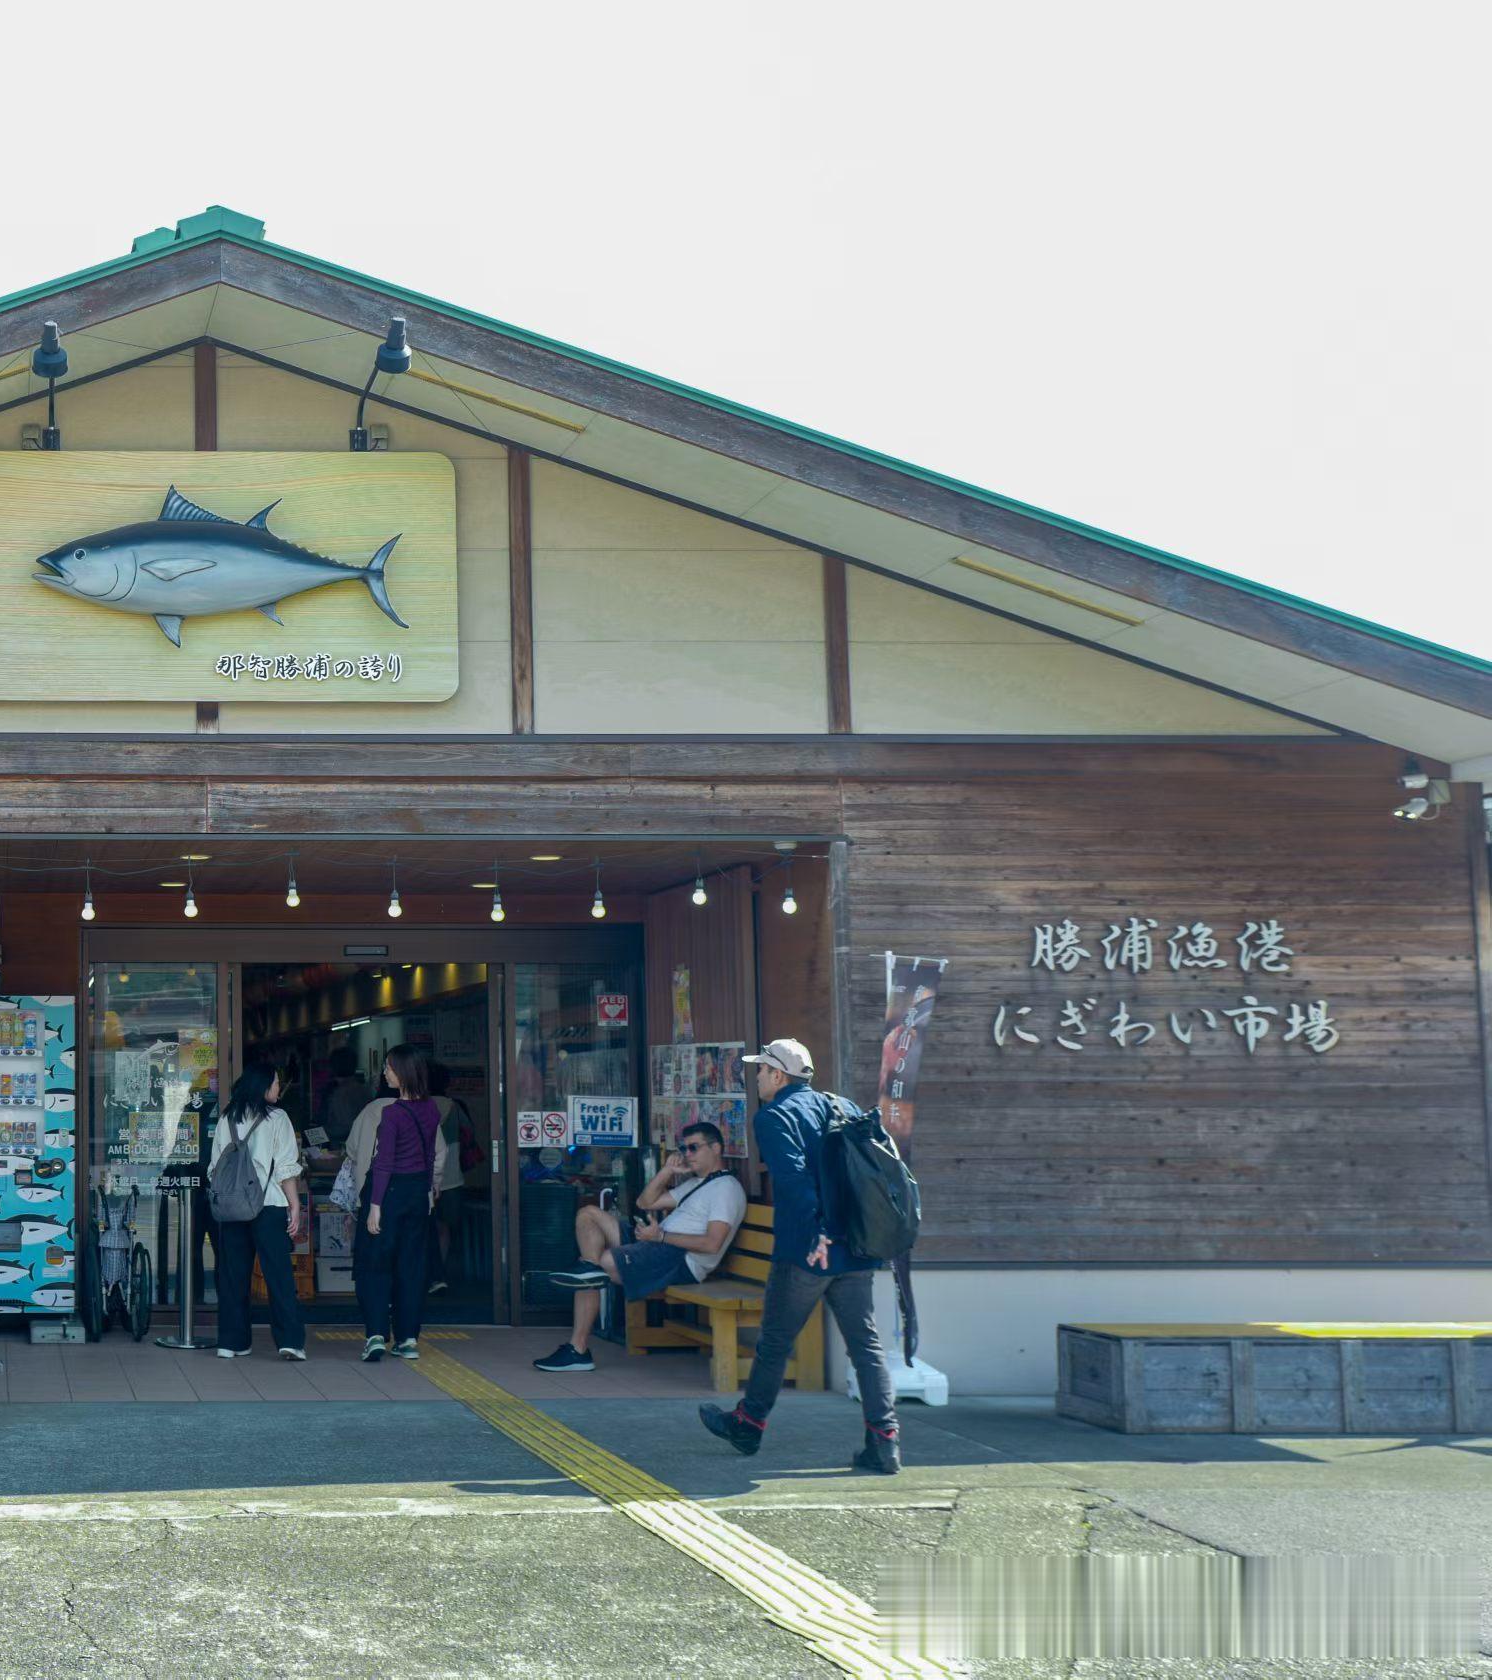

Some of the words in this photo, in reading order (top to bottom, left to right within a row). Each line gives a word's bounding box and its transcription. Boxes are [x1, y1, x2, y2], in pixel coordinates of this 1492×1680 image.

[216, 653, 402, 682] 那智勝浦の誇り
[1031, 917, 1294, 974] 勝浦漁港
[600, 996, 626, 1004] AED
[993, 994, 1341, 1055] にぎわい市場
[581, 1103, 610, 1113] Free!
